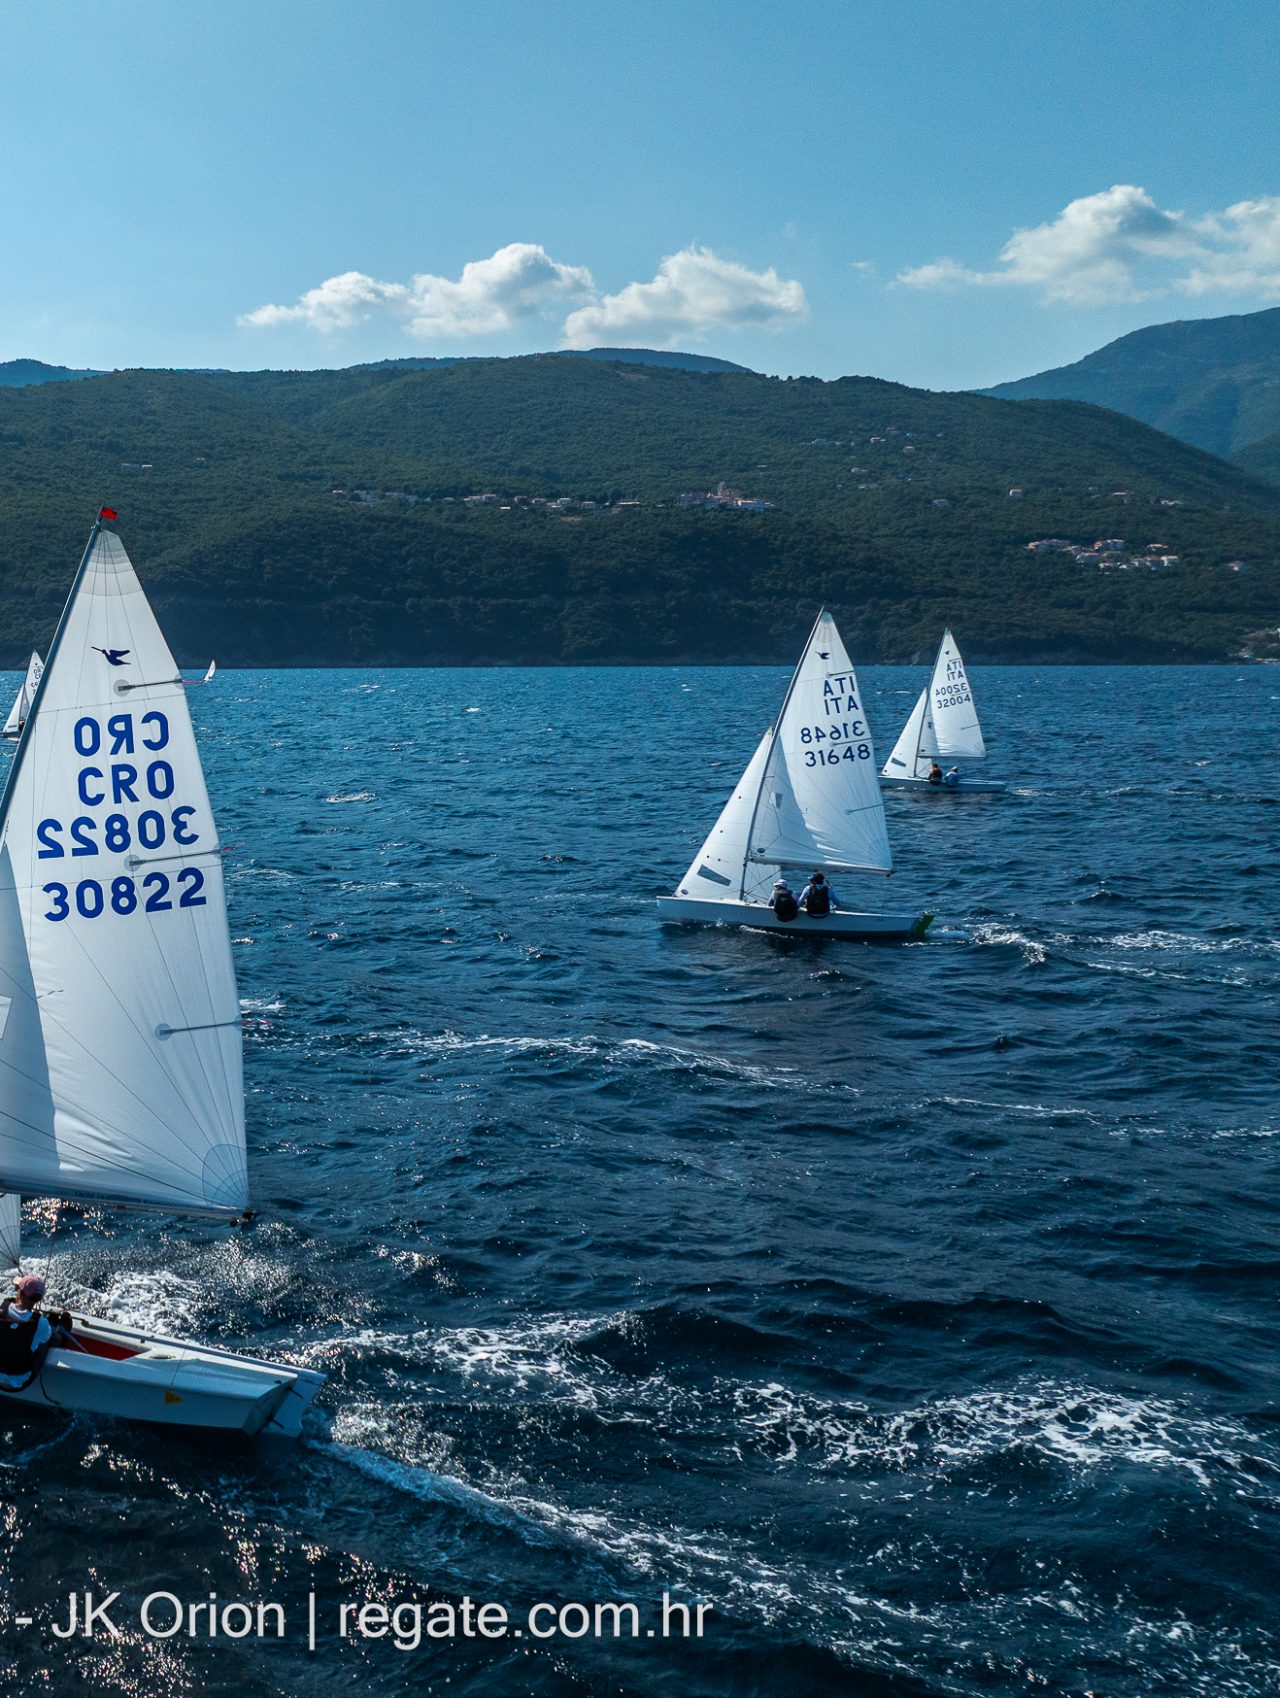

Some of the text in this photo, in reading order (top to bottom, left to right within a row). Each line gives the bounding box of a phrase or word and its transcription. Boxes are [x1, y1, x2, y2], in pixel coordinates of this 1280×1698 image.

[947, 670, 964, 681] ITA
[824, 695, 859, 715] ITA
[937, 694, 971, 709] 32004
[805, 743, 871, 767] 31648
[77, 760, 175, 807] CRO
[42, 866, 207, 922] 30822
